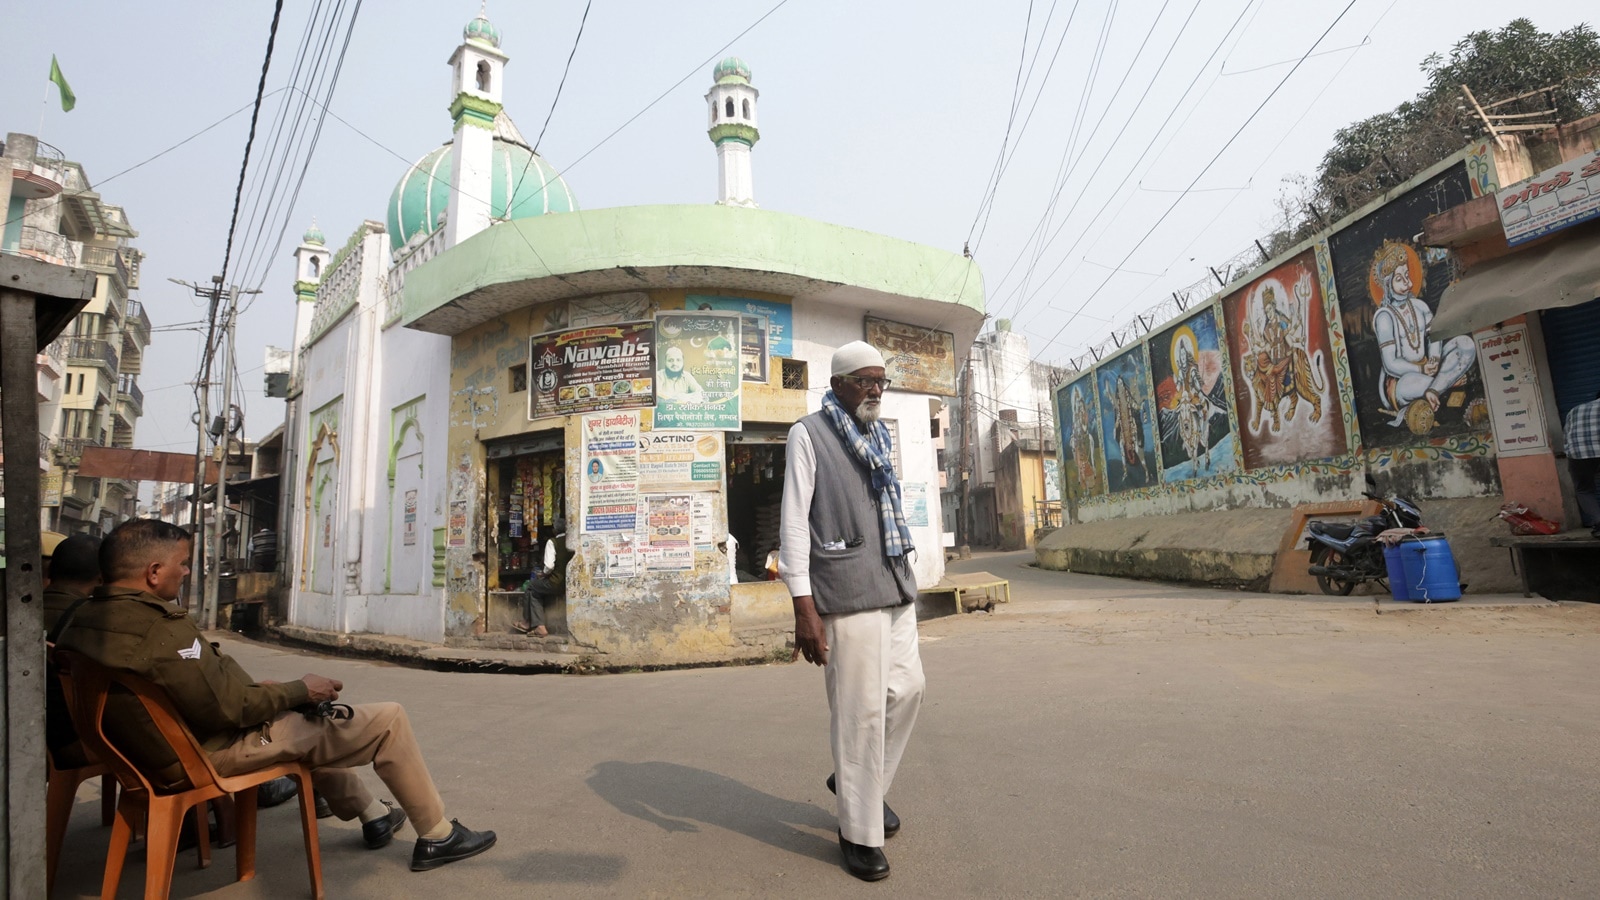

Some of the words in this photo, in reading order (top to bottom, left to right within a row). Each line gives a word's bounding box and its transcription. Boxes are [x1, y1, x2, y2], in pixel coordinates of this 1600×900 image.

[561, 331, 584, 342] GRAND
[585, 328, 617, 337] OPENING
[769, 325, 783, 335] FF
[564, 338, 651, 364] Nawab's
[573, 360, 600, 368] Family
[601, 355, 650, 365] Restaurant
[653, 435, 694, 443] ACTINO
